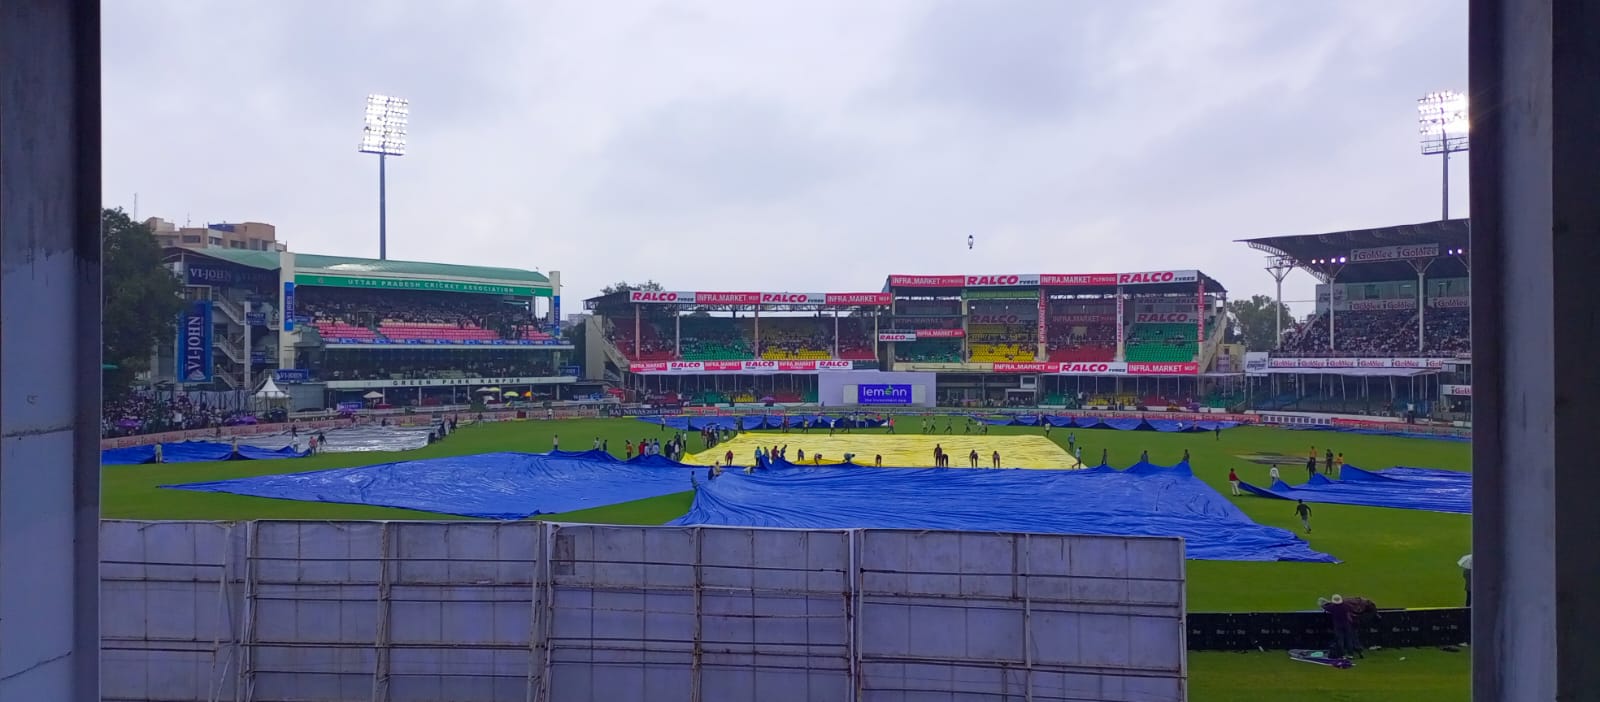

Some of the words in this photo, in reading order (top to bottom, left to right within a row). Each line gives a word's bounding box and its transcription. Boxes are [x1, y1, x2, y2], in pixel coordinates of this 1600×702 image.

[190, 268, 232, 281] VI-JOHN
[1119, 272, 1174, 283] RALCO
[892, 277, 940, 285] INFRA.MARKET
[967, 276, 1018, 286] RALCO
[1041, 276, 1091, 284] INFRA.MARKET
[347, 279, 377, 287] UTTAR
[381, 280, 421, 288] PRADESH
[463, 284, 514, 293] ASSOCIATION
[632, 292, 678, 301] RALCO
[696, 293, 746, 302] INFRA.MARKET
[762, 294, 808, 303] RALCO
[827, 294, 878, 303] INFRA.MARKET
[1137, 313, 1188, 322] RALCO
[917, 329, 953, 337] INFRA.MARKET
[188, 316, 202, 370] VI-JOHN
[994, 363, 1045, 371] INFRA.MARKET
[1061, 364, 1108, 373] RALCO
[1128, 364, 1183, 373] INFRA.MARKET
